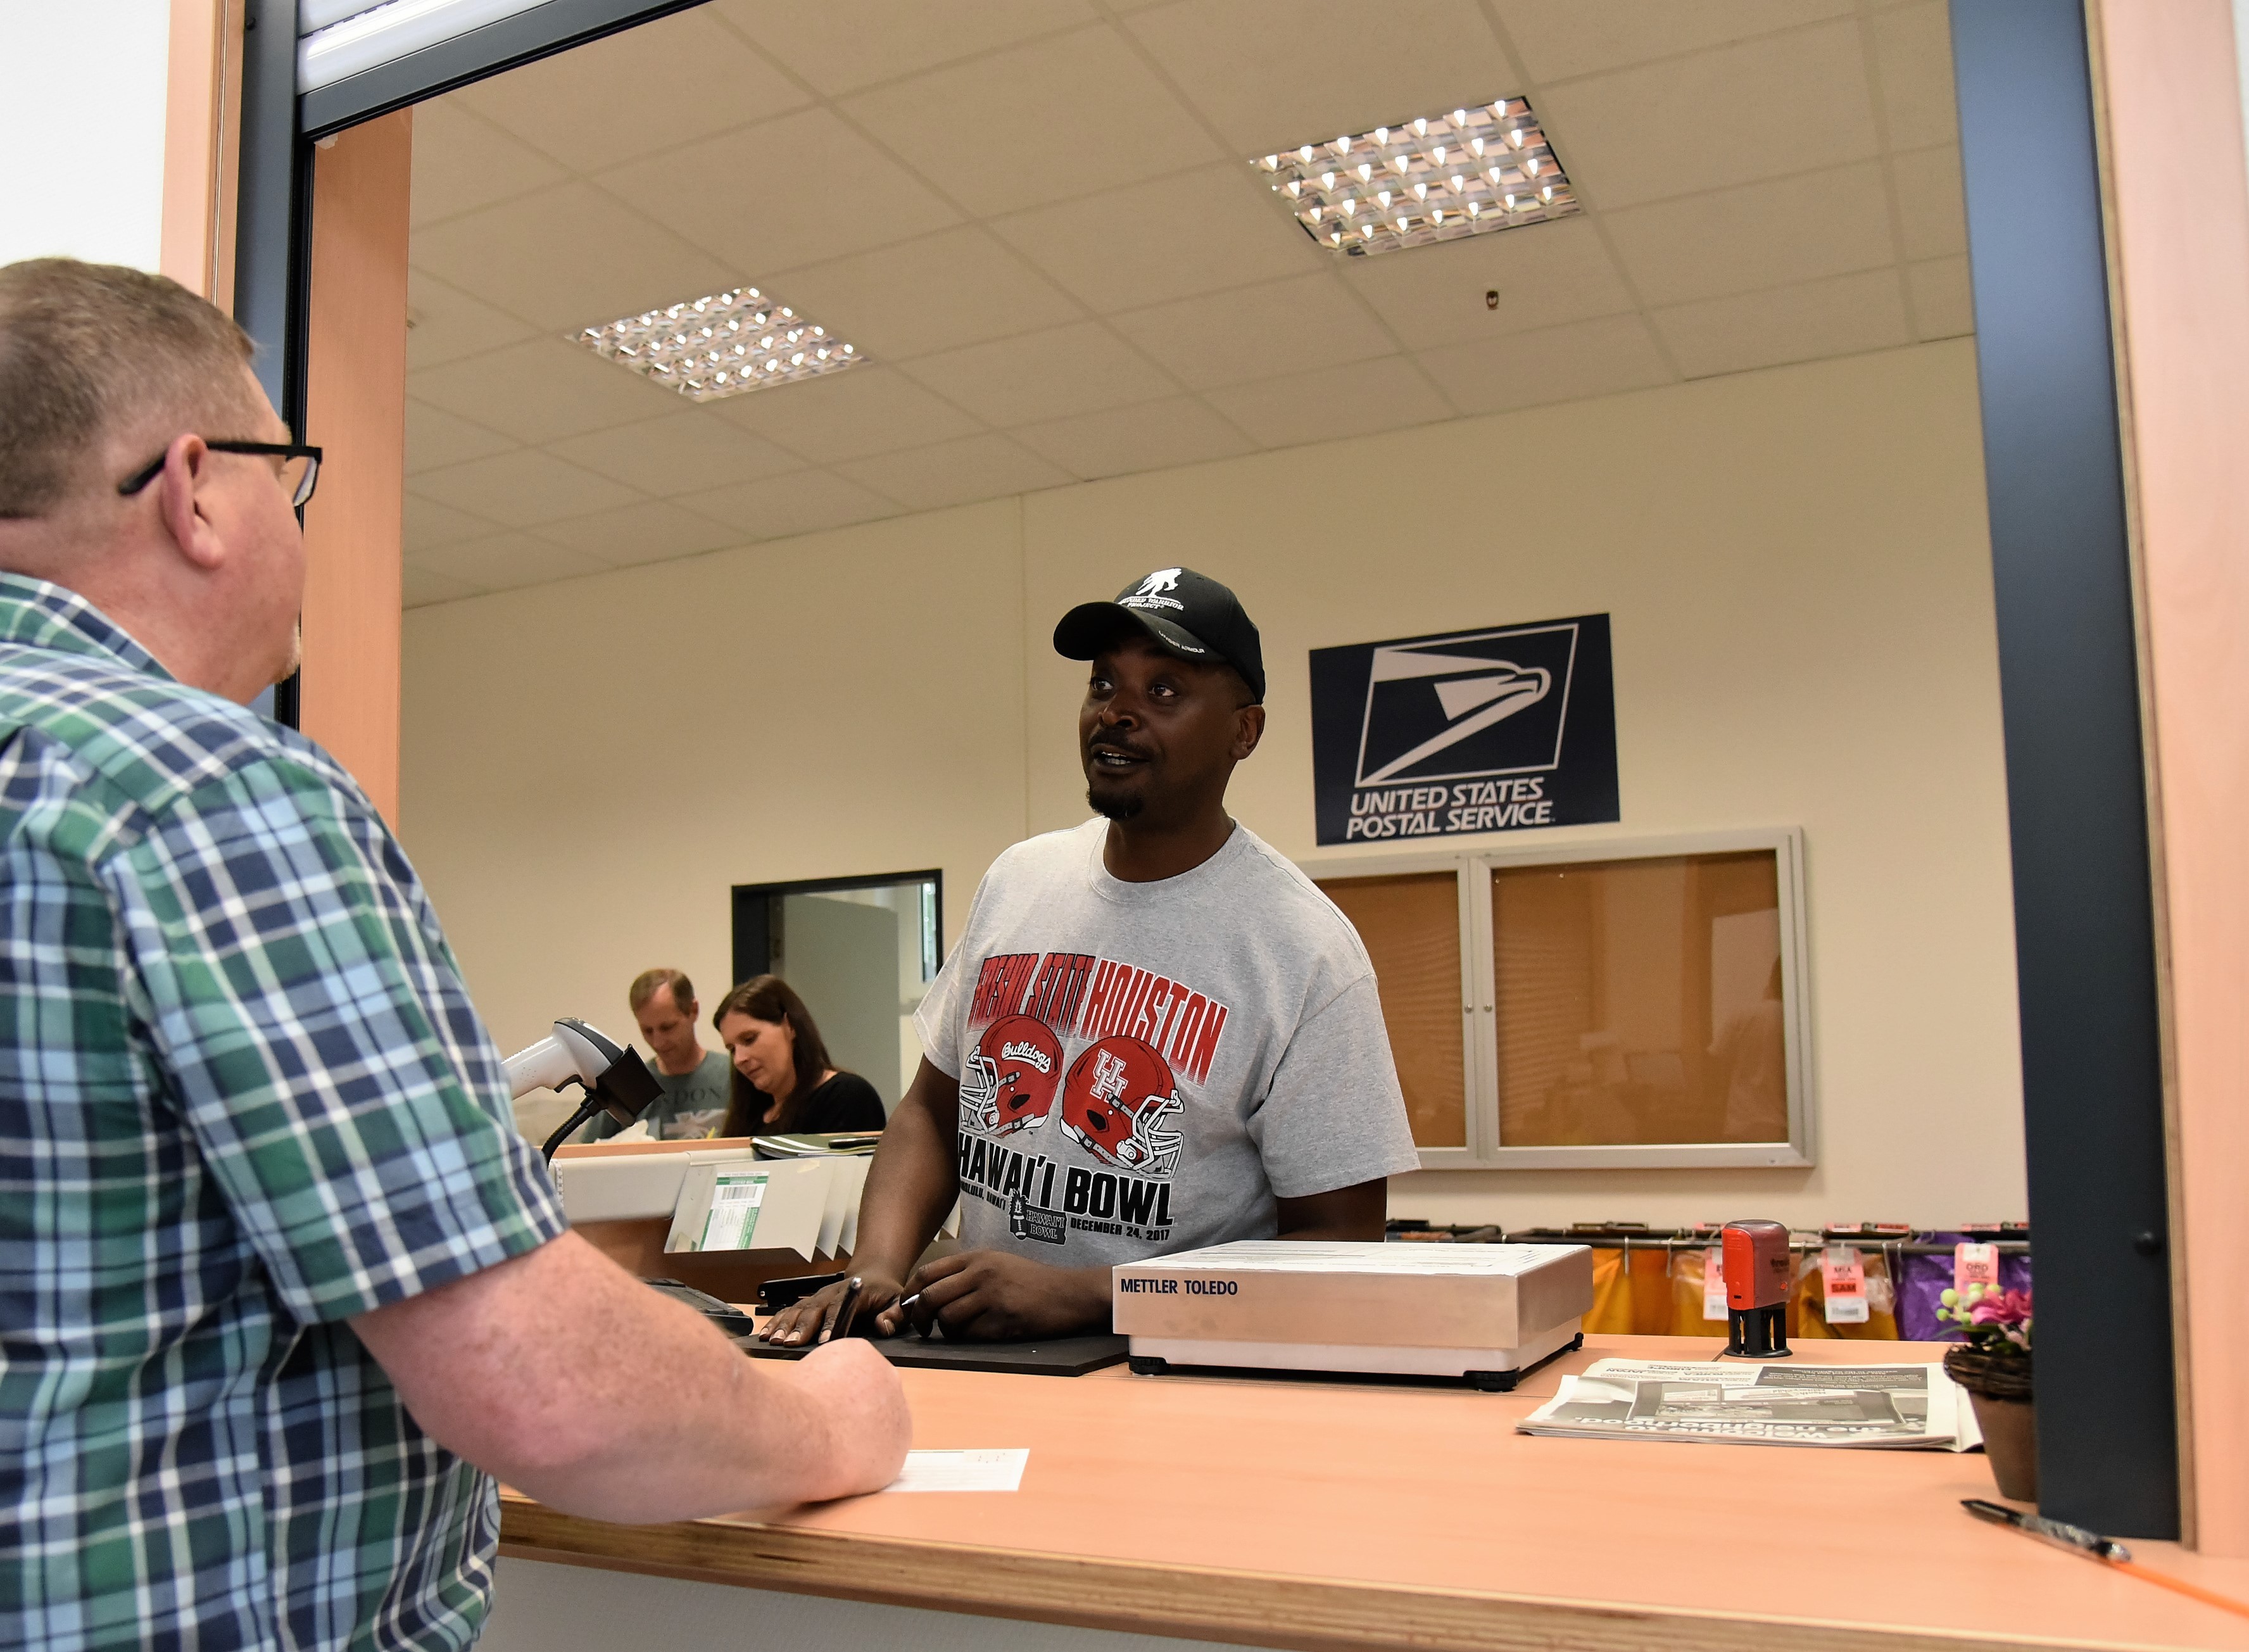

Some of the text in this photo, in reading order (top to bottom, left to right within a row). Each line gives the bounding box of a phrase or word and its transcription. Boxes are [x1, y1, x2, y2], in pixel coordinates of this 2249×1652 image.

[1158, 630, 1205, 653] UNDER ARMOUR
[1351, 776, 1545, 816] UNITED STATES
[1345, 800, 1554, 840] POSTAL SERVICE
[1024, 952, 1096, 1038] STATE
[1078, 958, 1230, 1090] HOUSTON
[1002, 1041, 1052, 1073] Bulldogs
[958, 1131, 1175, 1227] HAWAI'I BOWL
[1026, 1209, 1066, 1228] HAWAI'I
[1030, 1223, 1058, 1240] BOWL
[1070, 1217, 1123, 1235] DECEMBER
[1146, 1229, 1170, 1241] 2017
[1120, 1278, 1238, 1296] METTLER TOLEDO
